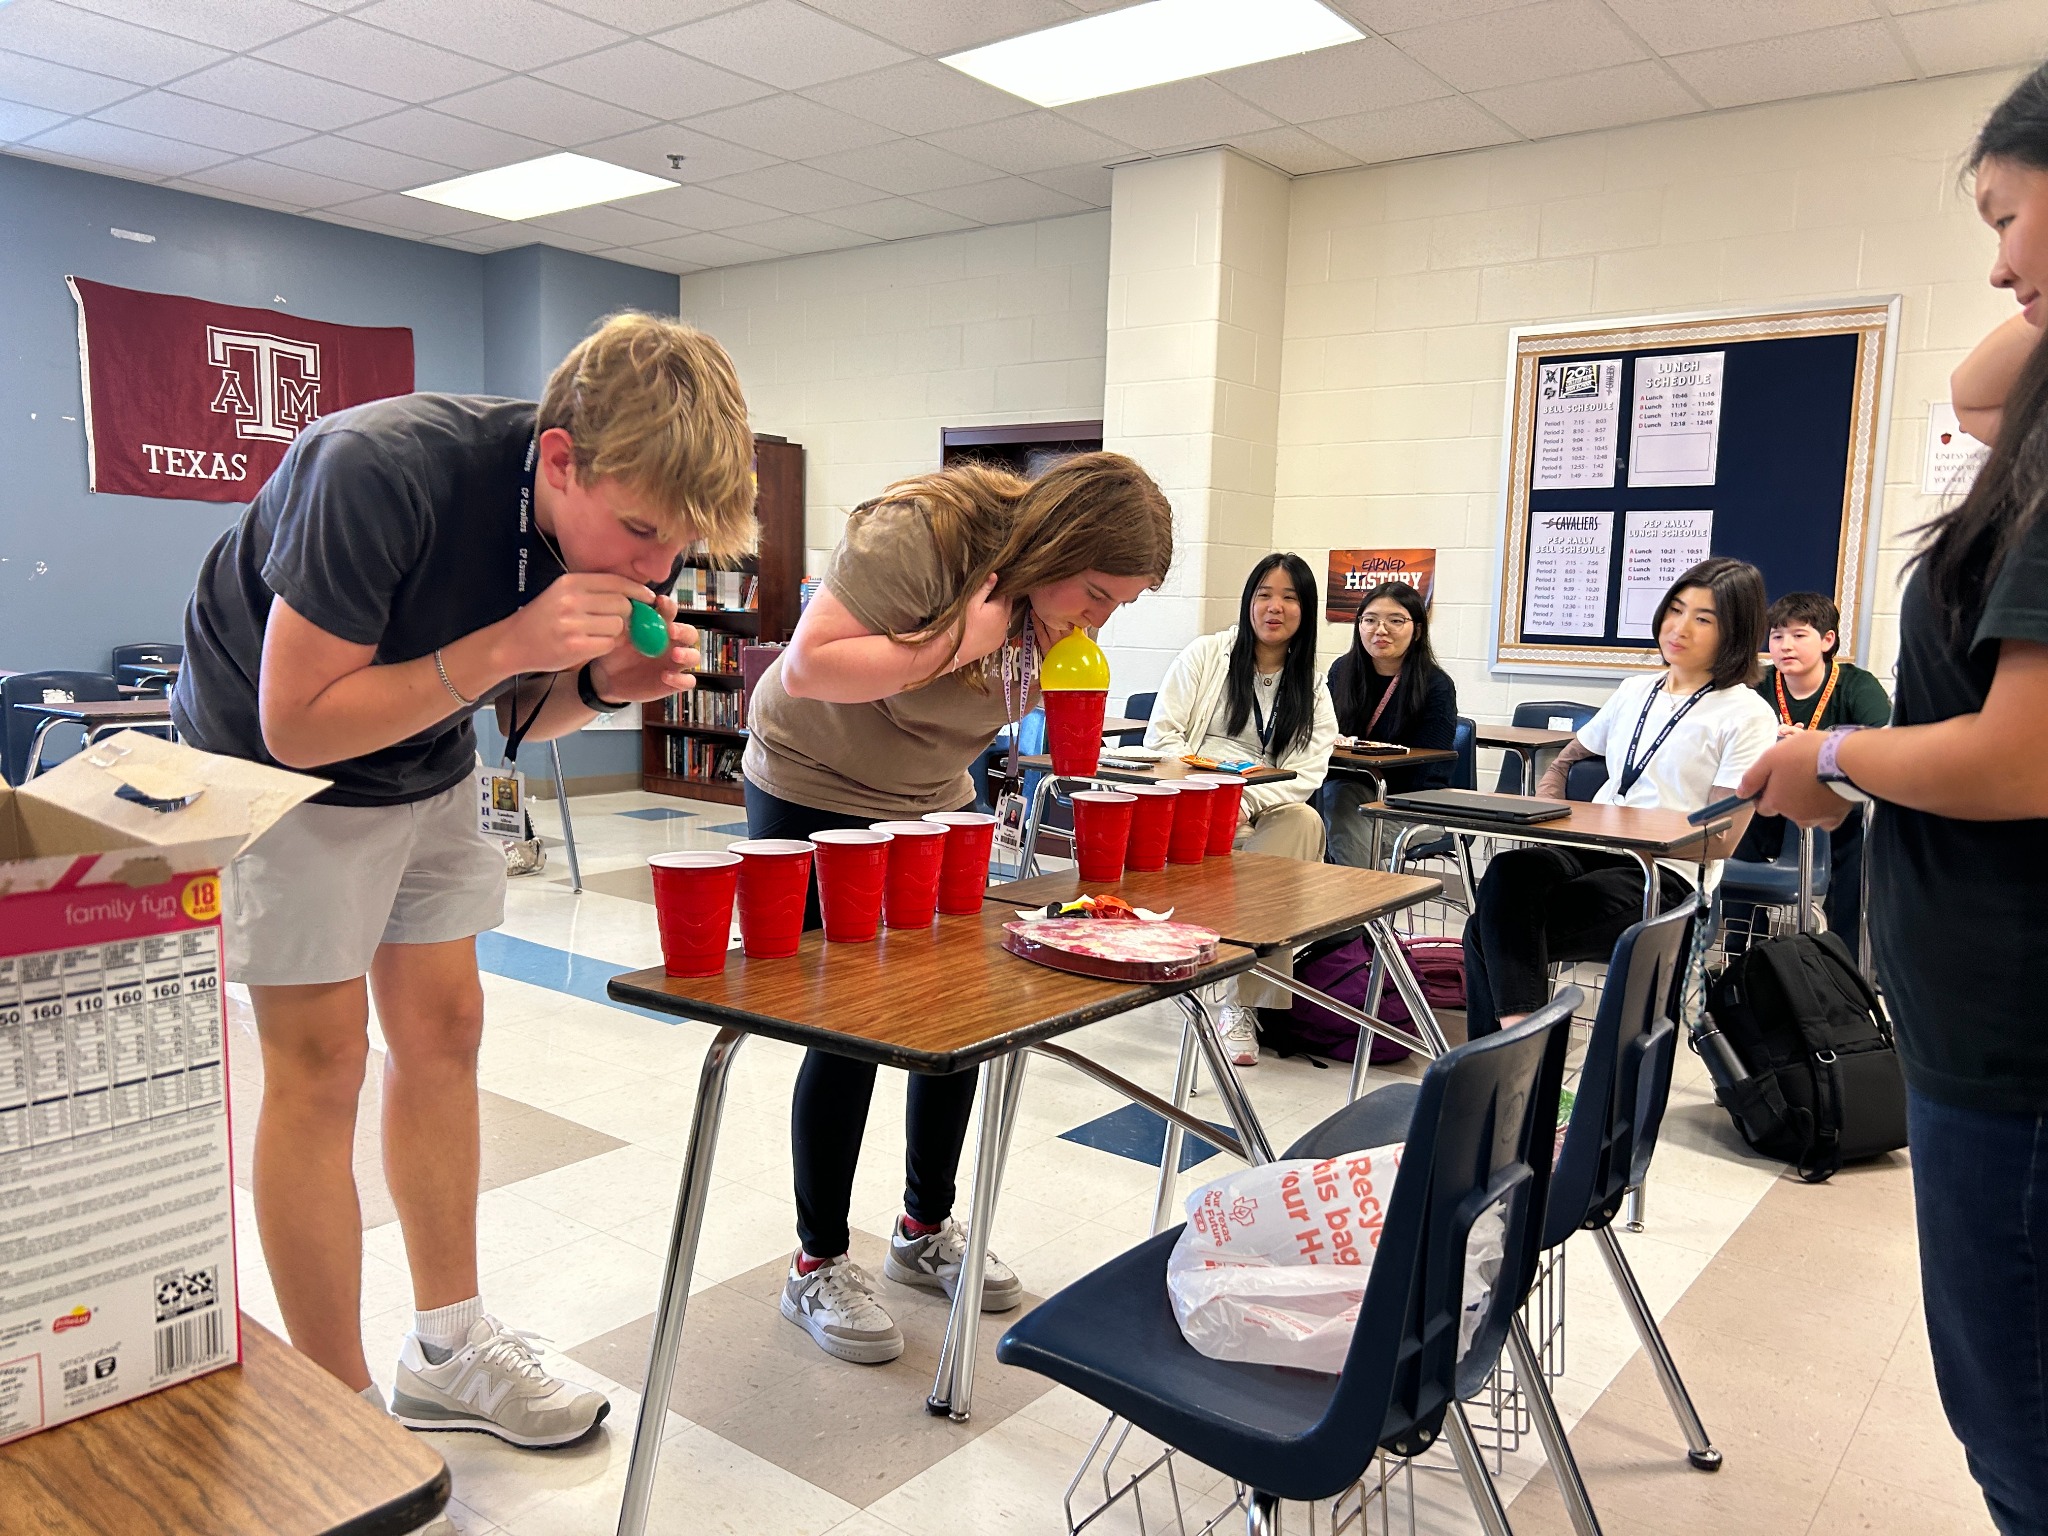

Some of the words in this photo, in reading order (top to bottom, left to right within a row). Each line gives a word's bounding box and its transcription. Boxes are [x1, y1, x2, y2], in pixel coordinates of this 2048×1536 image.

[1658, 361, 1700, 374] LUNCH
[1645, 374, 1712, 388] SCHEDULE
[1543, 404, 1564, 415] BELL
[1566, 402, 1614, 414] SCHEDULE
[142, 444, 247, 482] TEXAS
[521, 487, 530, 499] CP
[520, 499, 529, 533] Cavaliers
[1555, 516, 1598, 531] CAVALIERS
[1643, 520, 1661, 528] PEP
[1664, 520, 1693, 528] RALLY
[1547, 536, 1564, 545] PEP
[1567, 536, 1594, 545] RALLY
[1629, 530, 1658, 538] LUNCH
[1661, 529, 1707, 538] SCHEDULE
[519, 548, 528, 559] CP
[1535, 545, 1556, 554] BELL
[1559, 546, 1605, 554] SCHEDULE
[1362, 557, 1405, 572] EARNED
[1024, 635, 1033, 668] STATE
[192, 882, 215, 907] 18
[64, 897, 135, 926] family
[141, 893, 177, 915] fun
[31, 1004, 62, 1021] 160
[75, 997, 103, 1013] 110
[113, 990, 142, 1006] 160
[152, 983, 180, 999] 160
[190, 976, 217, 991] 140
[1213, 1191, 1223, 1207] Our
[1205, 1209, 1223, 1247] Future
[1216, 1210, 1232, 1242] Texas
